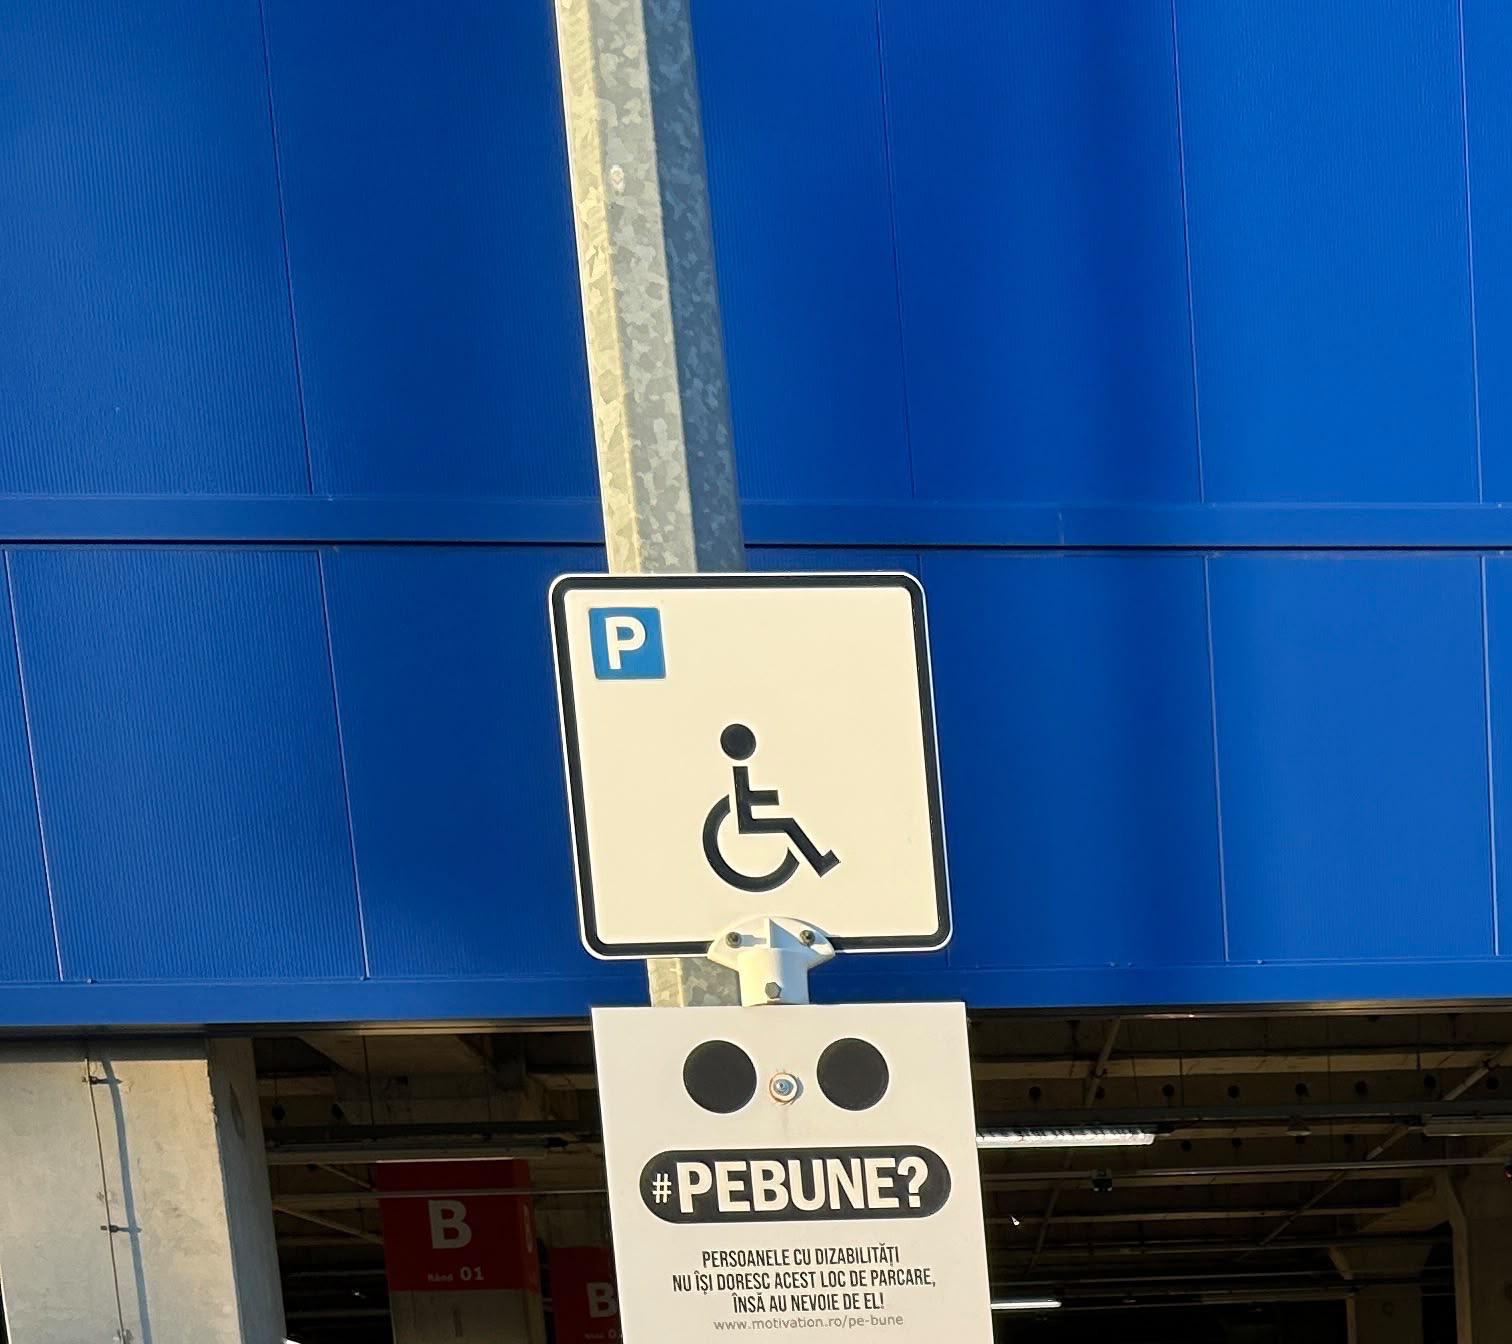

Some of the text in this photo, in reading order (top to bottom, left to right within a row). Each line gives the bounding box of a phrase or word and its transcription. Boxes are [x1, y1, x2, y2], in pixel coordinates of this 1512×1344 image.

[605, 616, 646, 669] P
[652, 1156, 928, 1213] #PEBUNE?
[428, 1199, 472, 1249] B
[702, 1242, 900, 1268] PERSOANELE CU DIZABILITĂȚI
[460, 1266, 485, 1281] 01
[672, 1268, 936, 1295] NU ÎȘI DORESC ACEST LOC DE PARCARE,
[587, 1282, 618, 1318] B
[732, 1291, 885, 1314] ÎNSĂ AU NEVOIE DE EL!
[713, 1315, 904, 1331] www.motivation.ro/pe-bune
